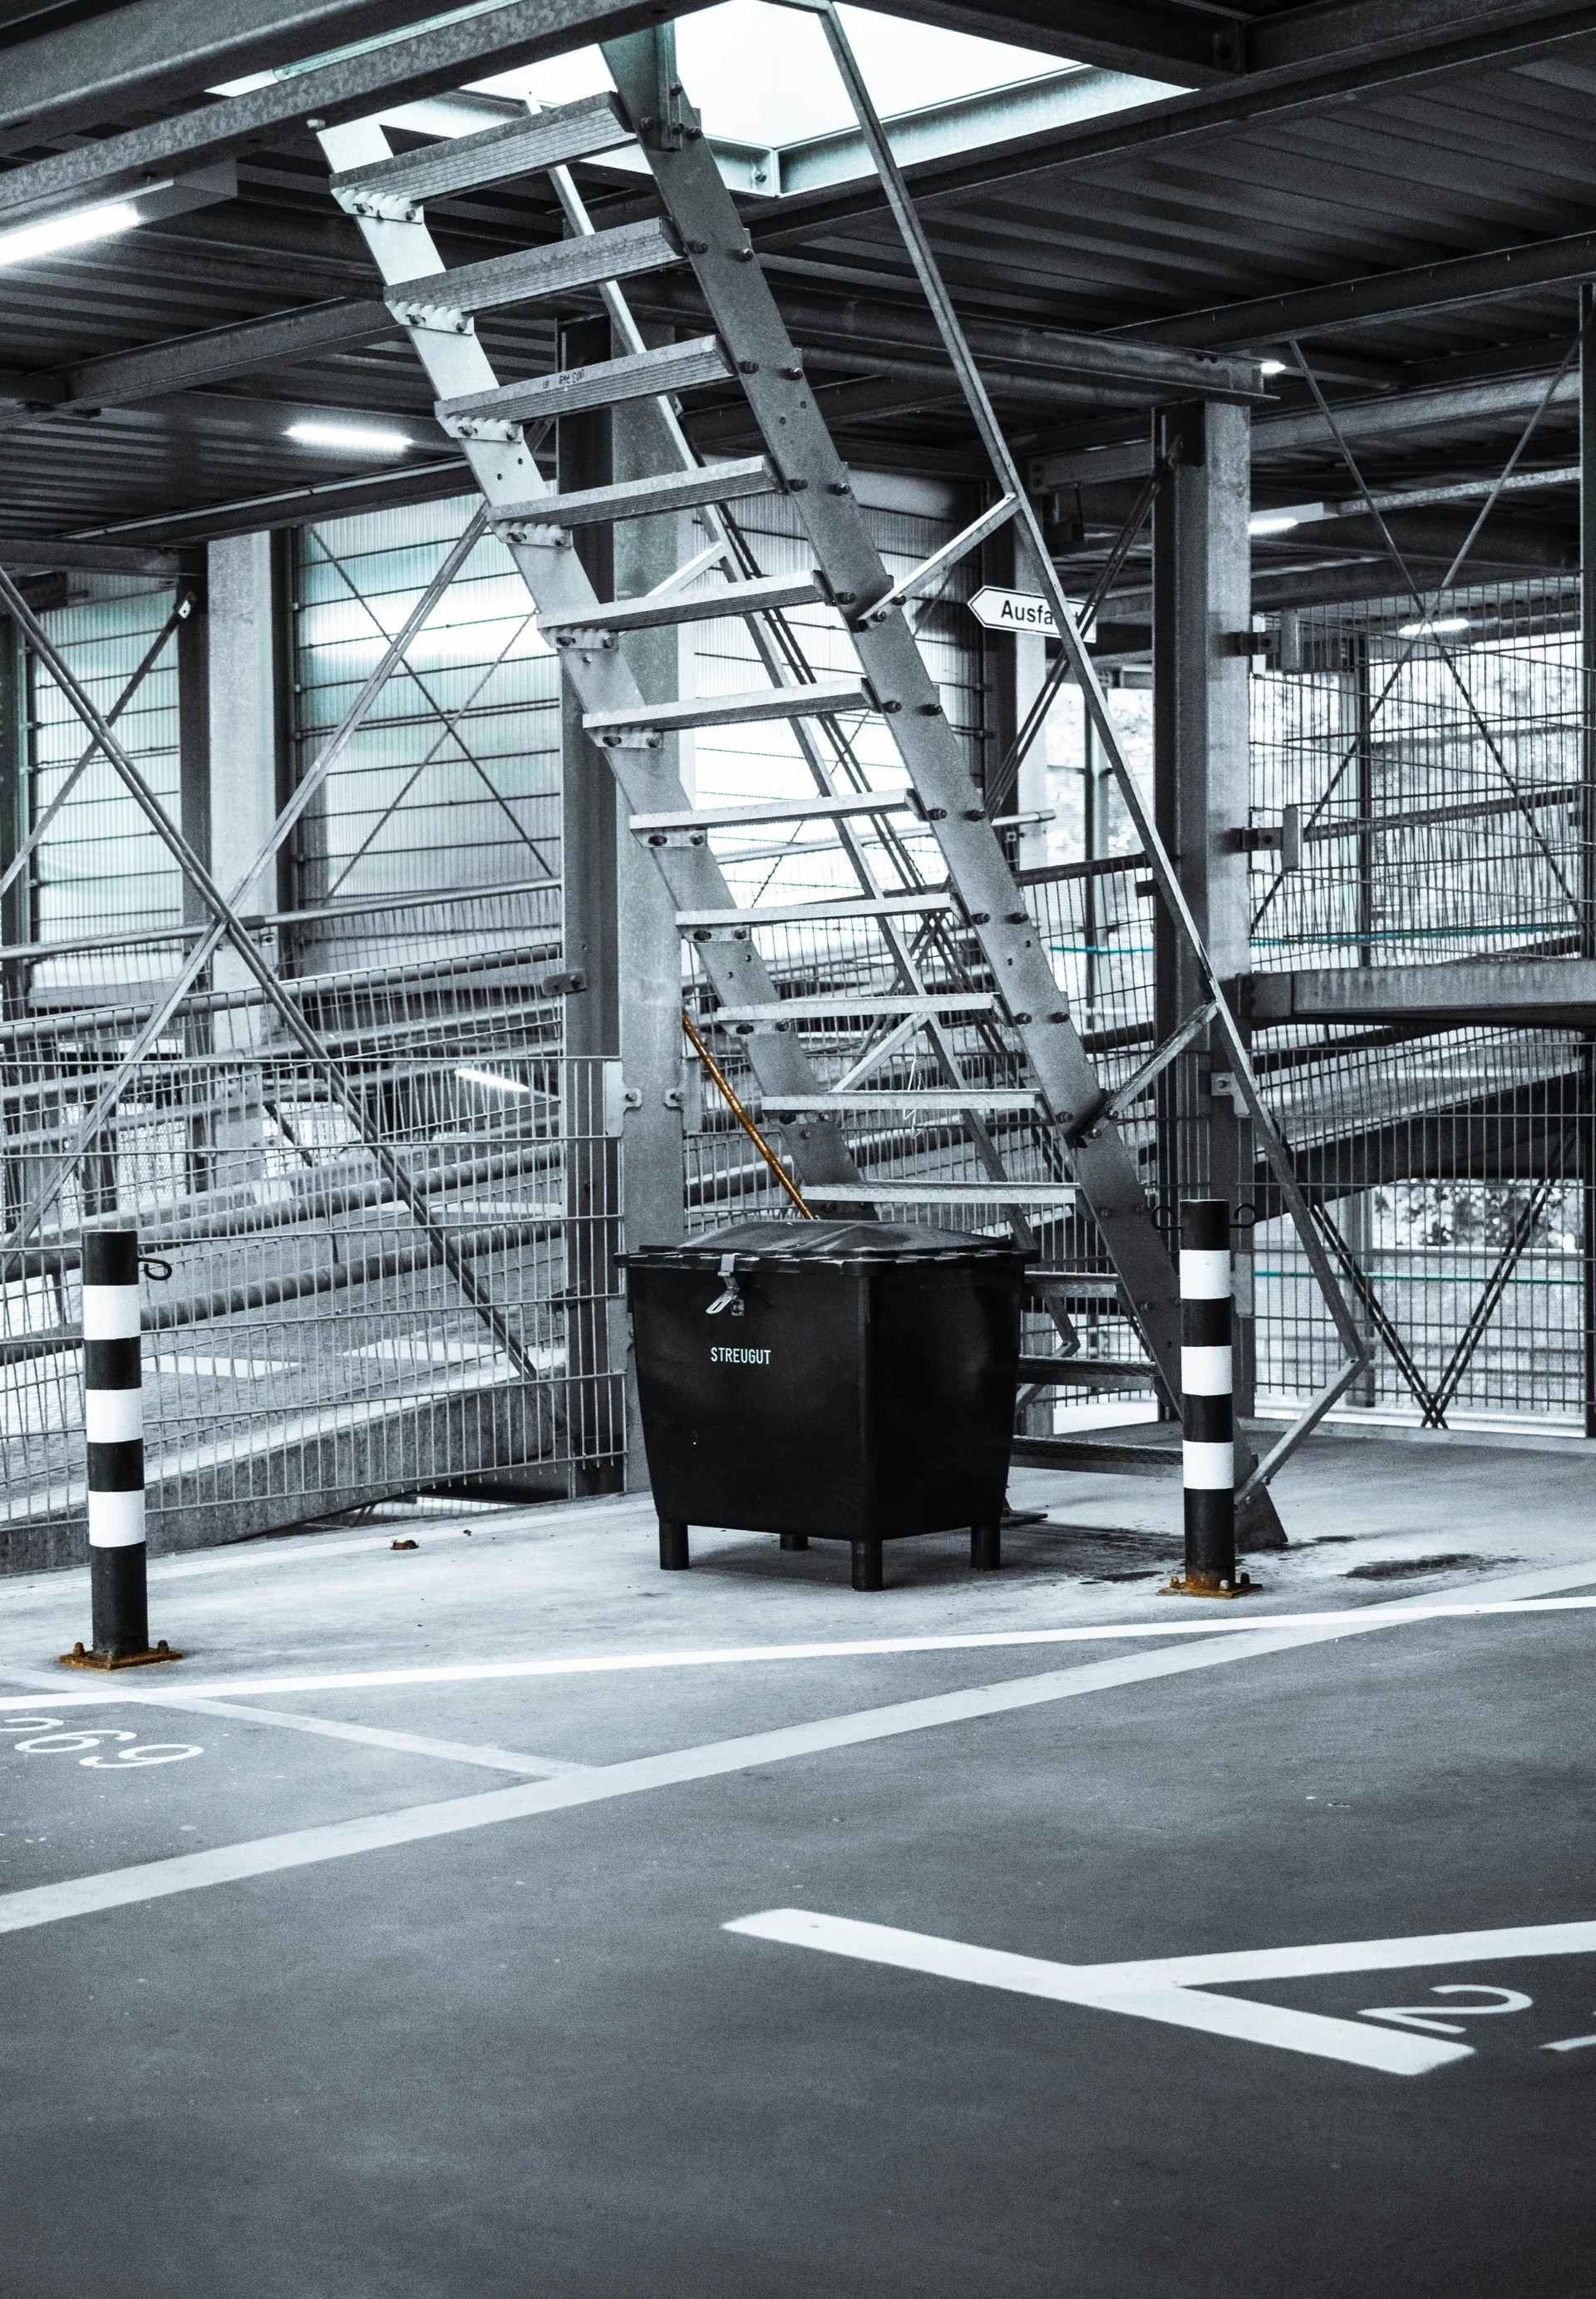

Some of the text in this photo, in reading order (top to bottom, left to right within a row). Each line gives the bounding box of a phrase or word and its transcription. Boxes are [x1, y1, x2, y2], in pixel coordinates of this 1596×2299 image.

[1001, 599, 1082, 629] Ausfat
[711, 1347, 771, 1364] STREUGUT
[1357, 1984, 1596, 2051] 2
